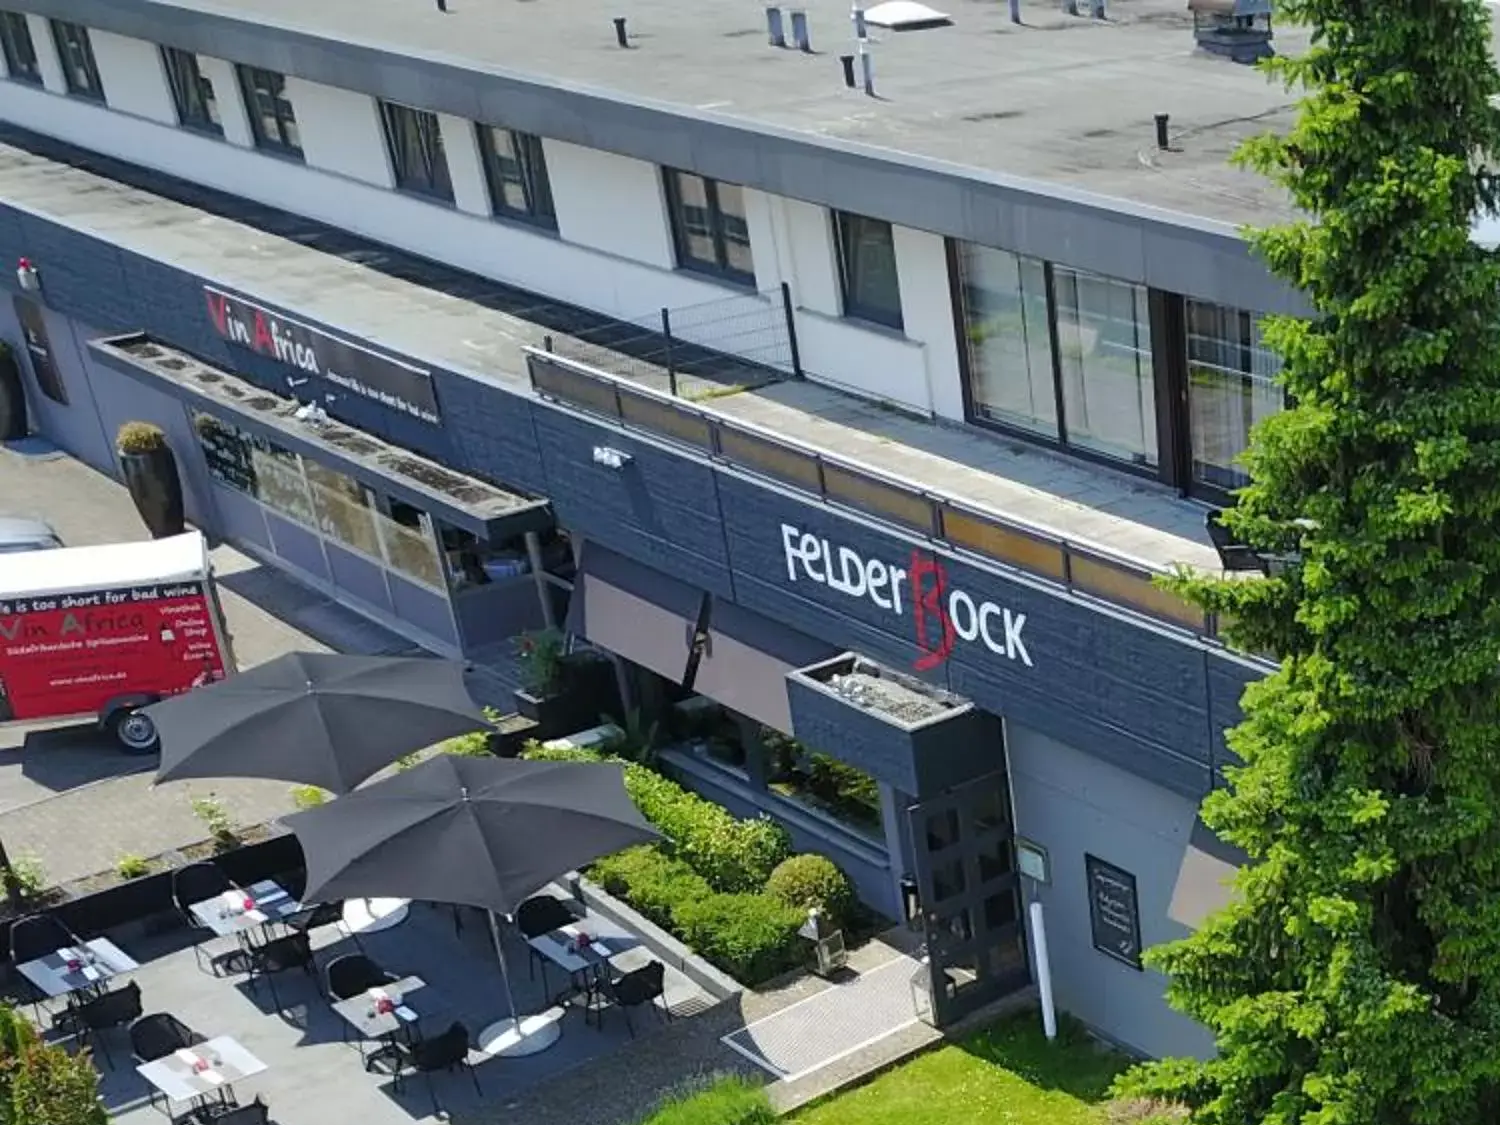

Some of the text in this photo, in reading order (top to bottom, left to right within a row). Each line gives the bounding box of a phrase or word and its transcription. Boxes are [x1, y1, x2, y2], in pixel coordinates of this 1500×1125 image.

[206, 292, 320, 374] Vin Africa
[16, 601, 28, 613] is
[32, 600, 57, 611] too
[61, 595, 101, 609] short
[105, 590, 127, 604] for
[131, 587, 159, 601] bad
[163, 585, 198, 597] wine
